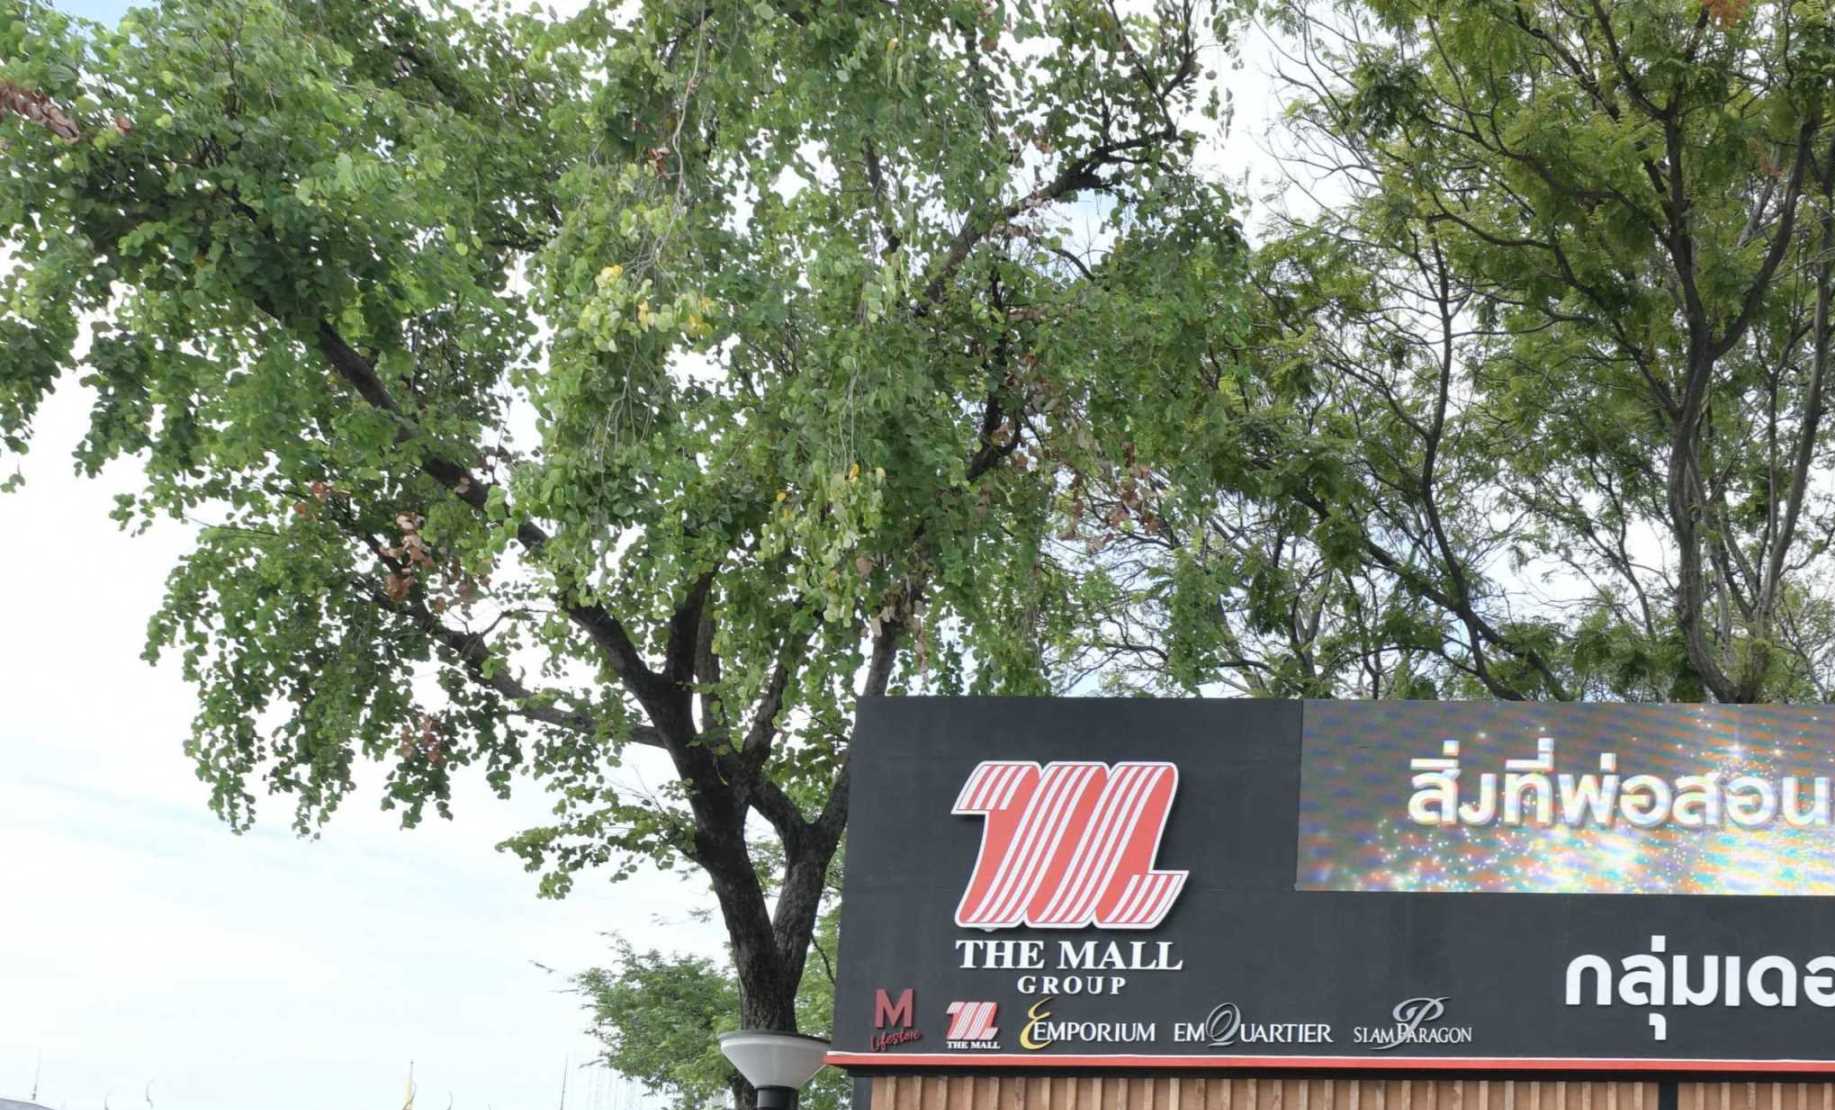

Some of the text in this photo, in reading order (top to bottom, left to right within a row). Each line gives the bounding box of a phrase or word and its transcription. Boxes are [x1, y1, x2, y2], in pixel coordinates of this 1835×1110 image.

[1407, 737, 1833, 829] สิ่งที่พ่อสอน
[955, 939, 1184, 971] THE MALL
[1016, 975, 1127, 996] GROUP
[874, 988, 913, 1029] M
[946, 1041, 1000, 1049] THE MALL
